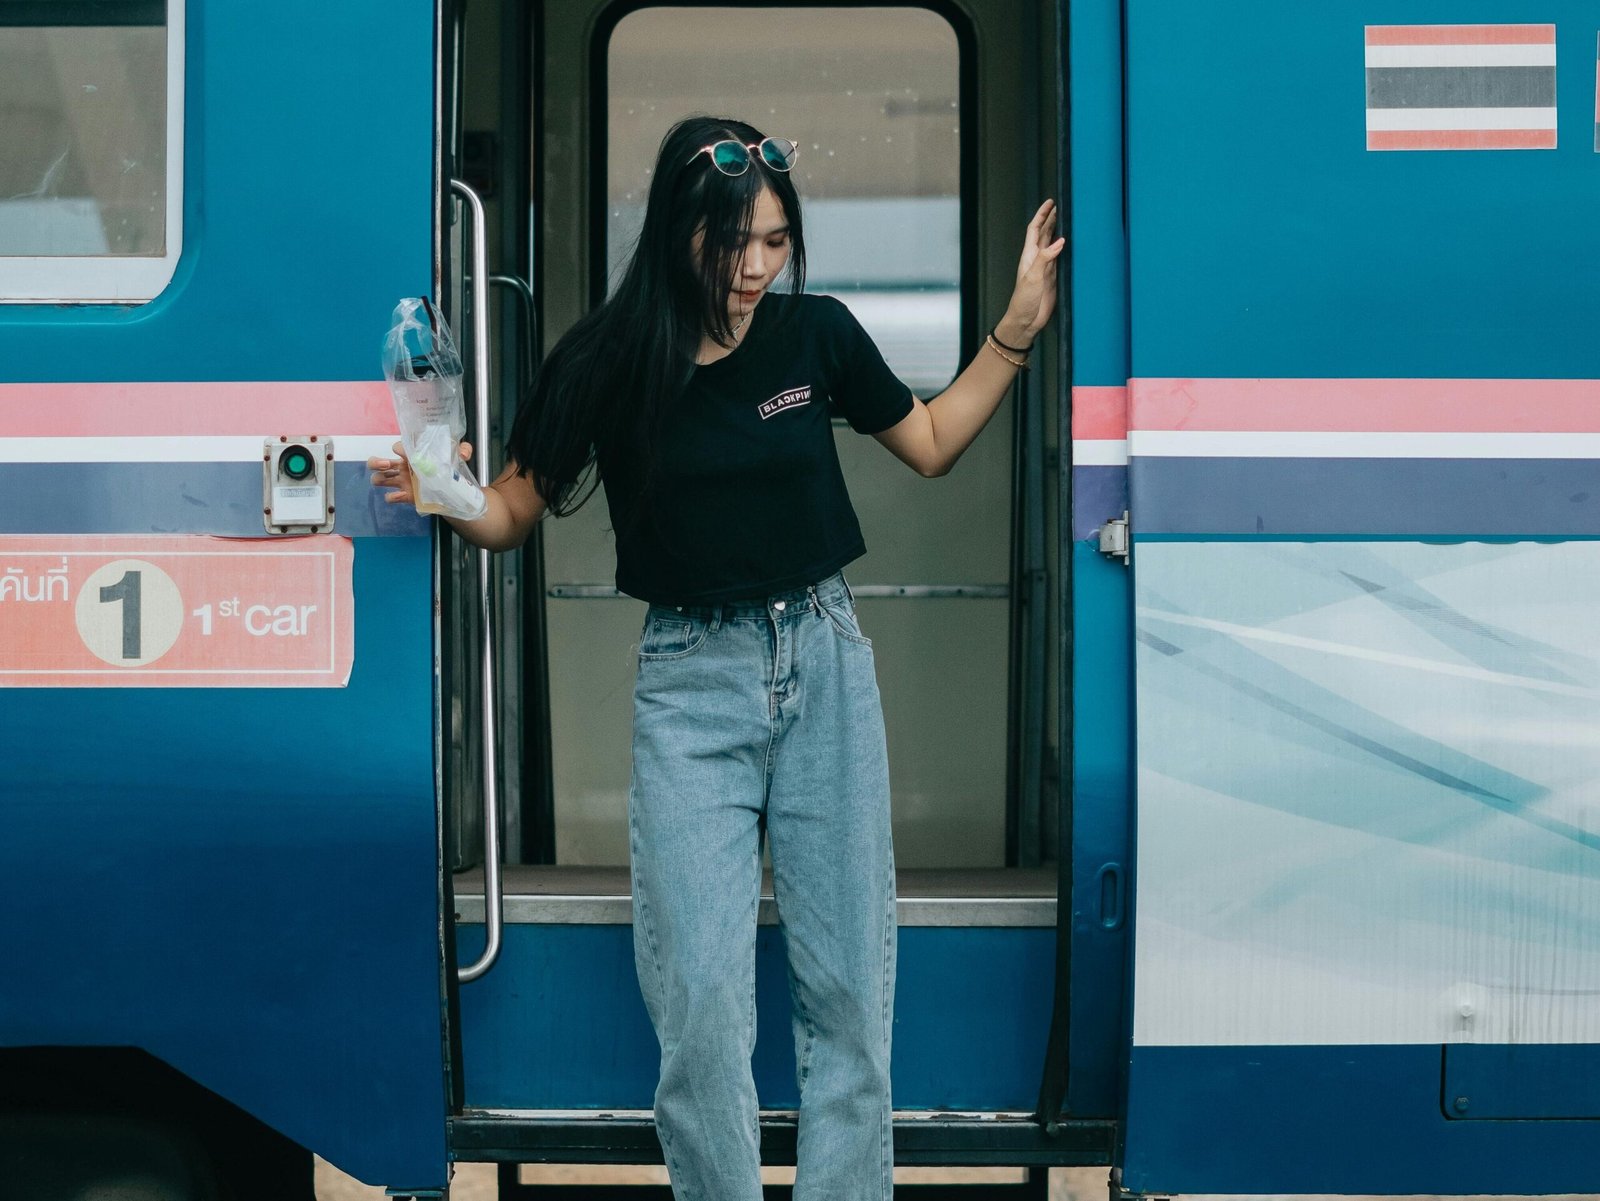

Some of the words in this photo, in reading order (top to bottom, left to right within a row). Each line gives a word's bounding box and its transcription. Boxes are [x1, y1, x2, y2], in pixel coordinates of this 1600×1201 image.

[763, 388, 812, 413] BLACKPIN
[0, 556, 69, 602] คันที่
[99, 570, 142, 660] 1
[192, 596, 240, 635] 1st
[244, 604, 317, 636] car
